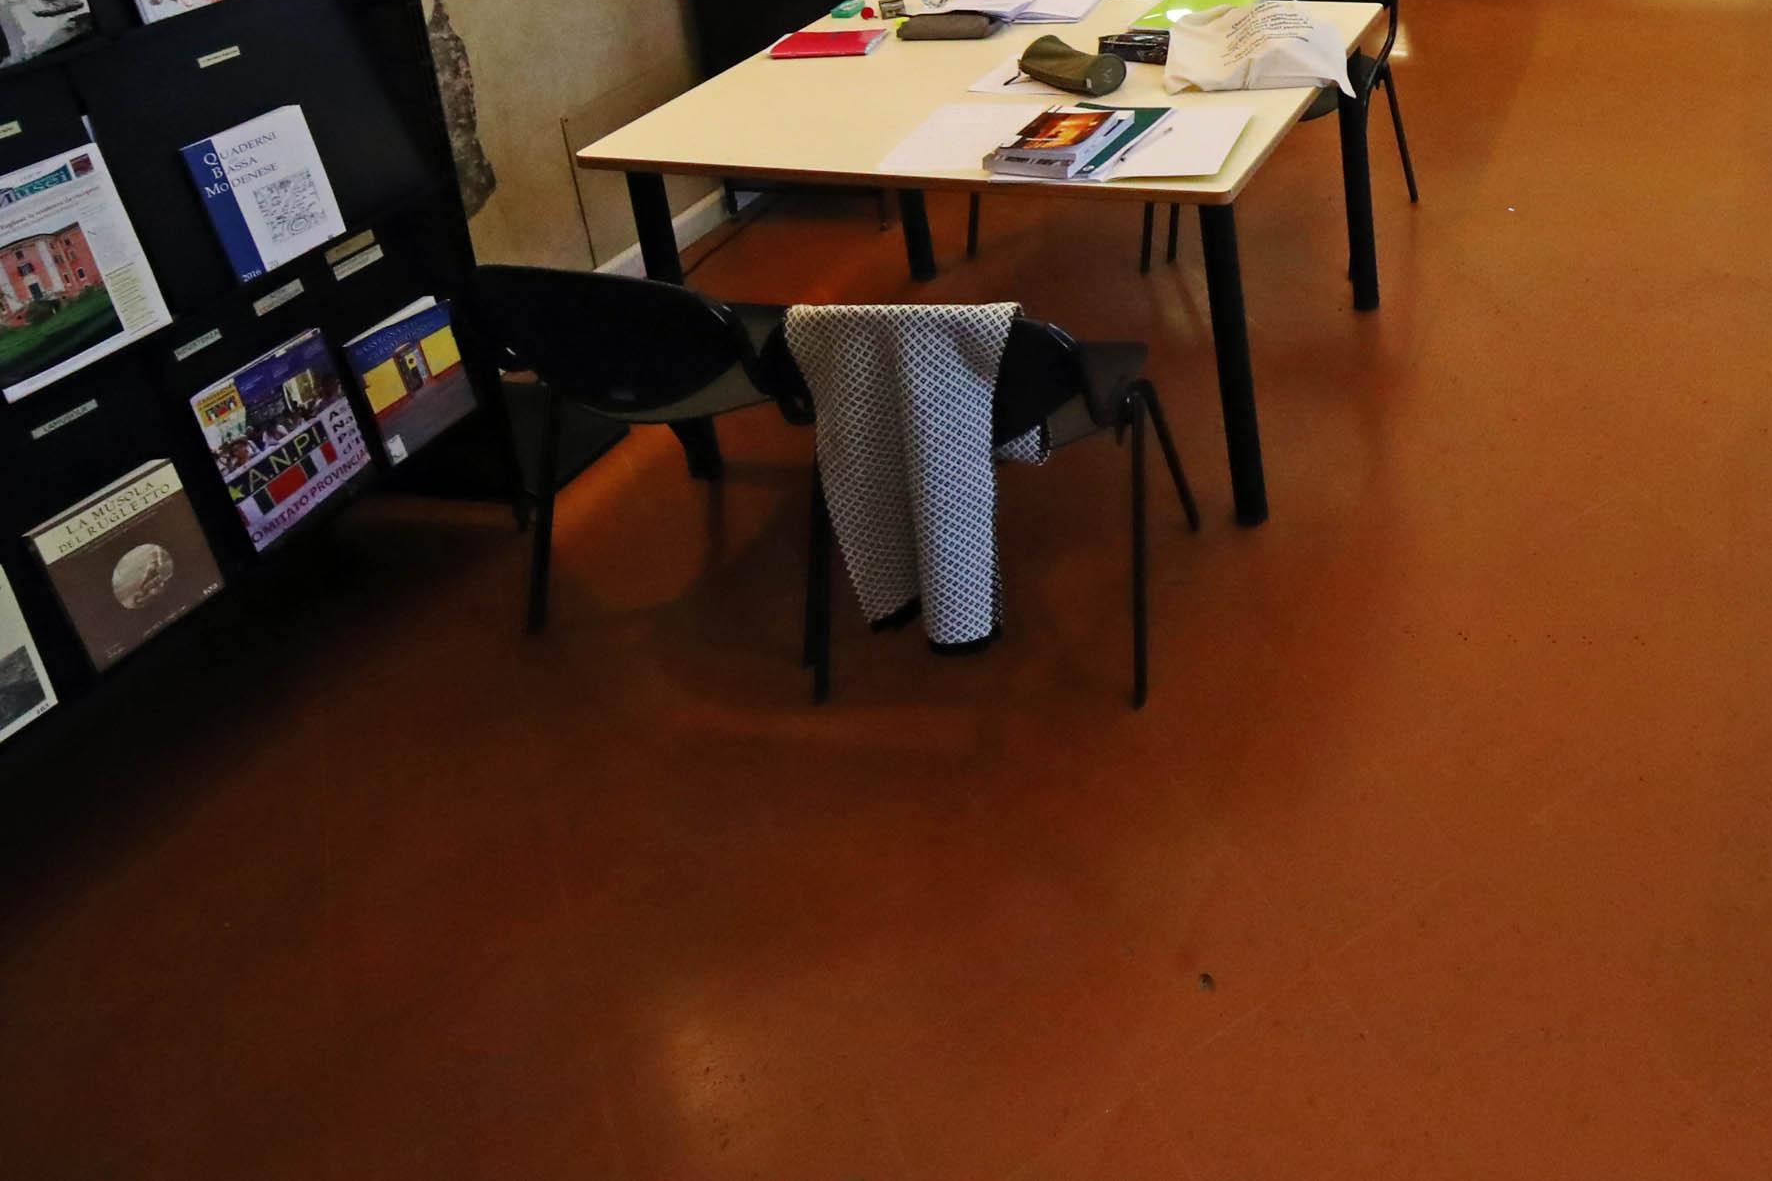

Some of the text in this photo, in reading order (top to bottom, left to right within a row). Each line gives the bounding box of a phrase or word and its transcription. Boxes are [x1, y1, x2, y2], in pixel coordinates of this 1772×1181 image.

[203, 131, 279, 167] QUADERNI
[213, 156, 258, 178] BASSA
[58, 535, 84, 554] DEL
